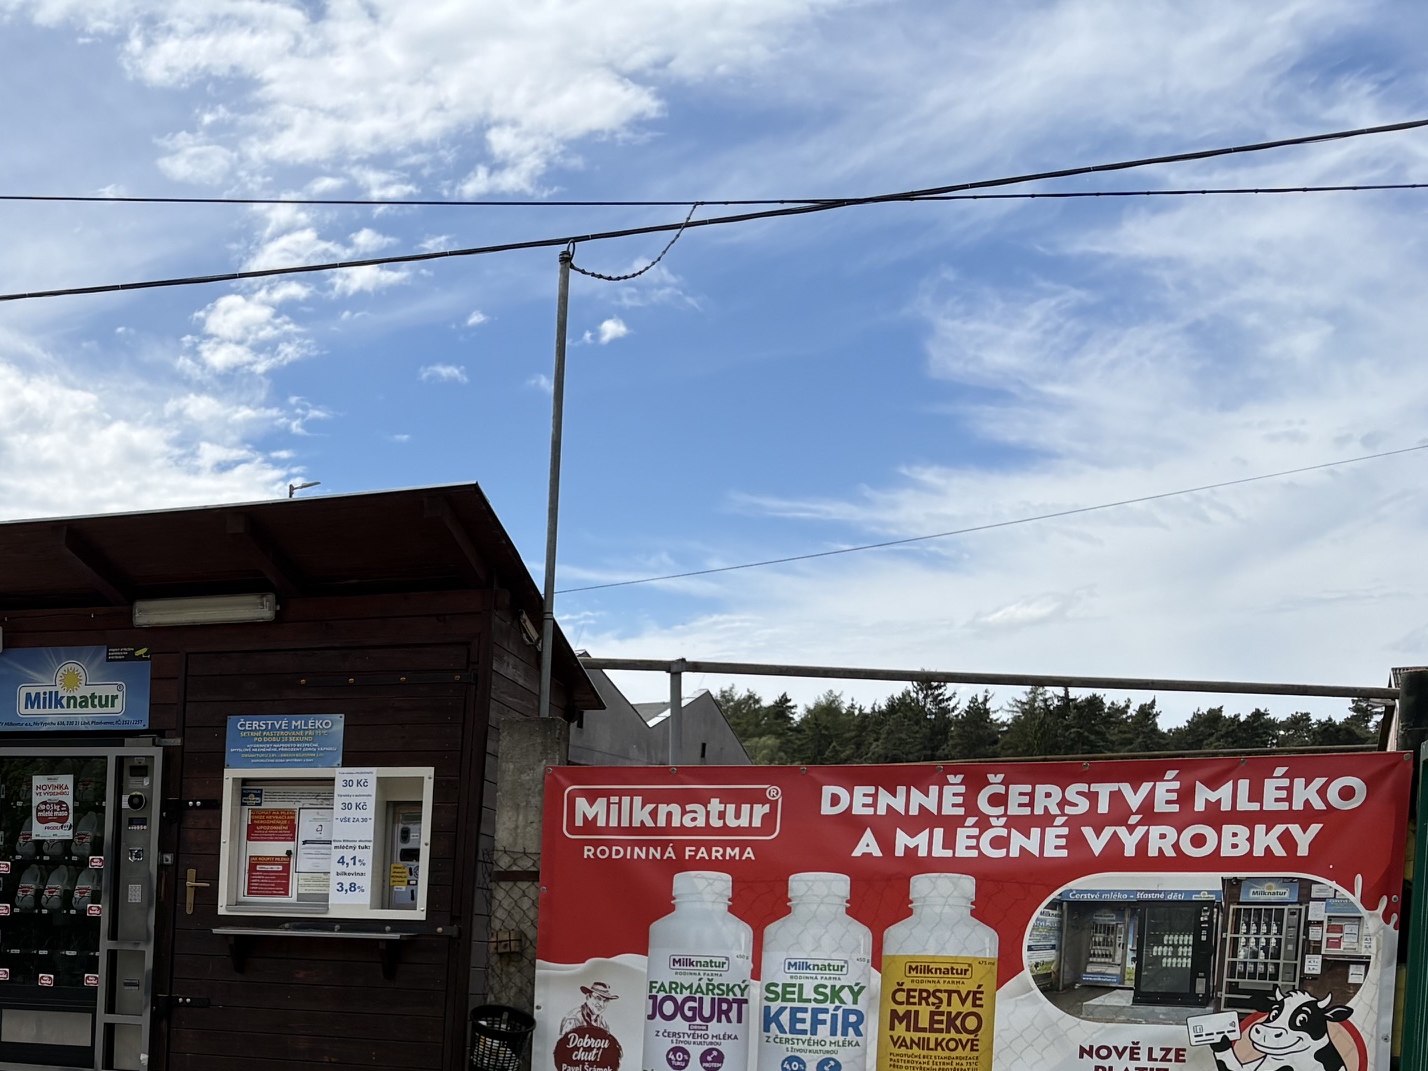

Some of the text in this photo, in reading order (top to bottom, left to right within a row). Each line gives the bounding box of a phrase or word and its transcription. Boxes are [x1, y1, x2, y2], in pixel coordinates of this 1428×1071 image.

[24, 690, 119, 710] Milknatur
[237, 717, 332, 731] ČERSTVÉ MLÉKO
[342, 778, 369, 788] 30 Kč
[820, 766, 1367, 817] DENNĚ ČERSTVÉ MLÉKO
[341, 801, 368, 810] 30 Kč
[851, 814, 1324, 859] A MLÉČNÉ VÝROBKY
[583, 843, 756, 861] RODINNÁ FARMA
[337, 855, 366, 868] 4,1%
[336, 882, 365, 895] 3,8%
[1069, 890, 1185, 900] Čerstvé mléko šťastné děti
[672, 957, 726, 969] Milknatur
[787, 961, 845, 972] Milknatur
[908, 964, 969, 976] Milknatur
[648, 977, 749, 997] FARMÁŘSKÝ
[763, 982, 867, 1005] SELSKÝ
[891, 982, 984, 1008] ČERSTVÉ
[647, 994, 748, 1024] JOGURT
[889, 1005, 983, 1035] MLÉKO
[566, 1032, 610, 1049] Dobrou
[662, 1029, 710, 1040] ČERSTVÉHO
[711, 1032, 738, 1041] MLÉKA
[675, 1038, 692, 1046] ŽIVOU
[765, 1034, 860, 1048] Z ČERSTVÉHO MLÉKA
[790, 1046, 808, 1054] ŽIVOU
[889, 1034, 980, 1052] VANILKOVÉ
[572, 1047, 603, 1061] chuť!
[1078, 1040, 1187, 1063] NOVĚ LZE
